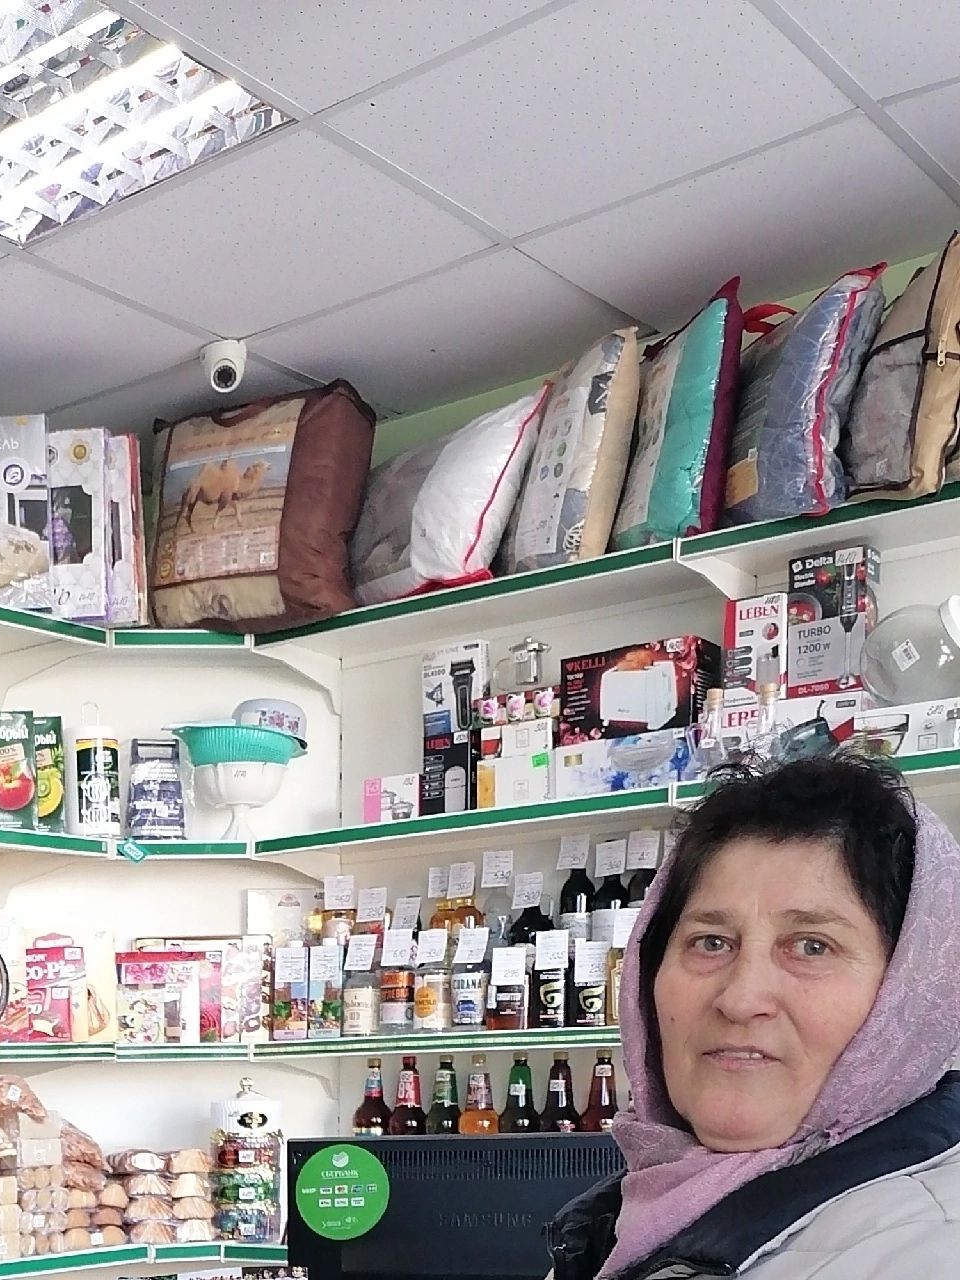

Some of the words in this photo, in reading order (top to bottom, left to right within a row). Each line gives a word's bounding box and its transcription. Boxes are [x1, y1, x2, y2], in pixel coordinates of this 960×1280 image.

[805, 556, 834, 570] Delta
[739, 604, 780, 621] LEBEN
[798, 625, 832, 640] TURBO
[798, 643, 822, 654] 1200
[573, 656, 606, 673] KELLI
[440, 1211, 534, 1228] SAMSUNG
